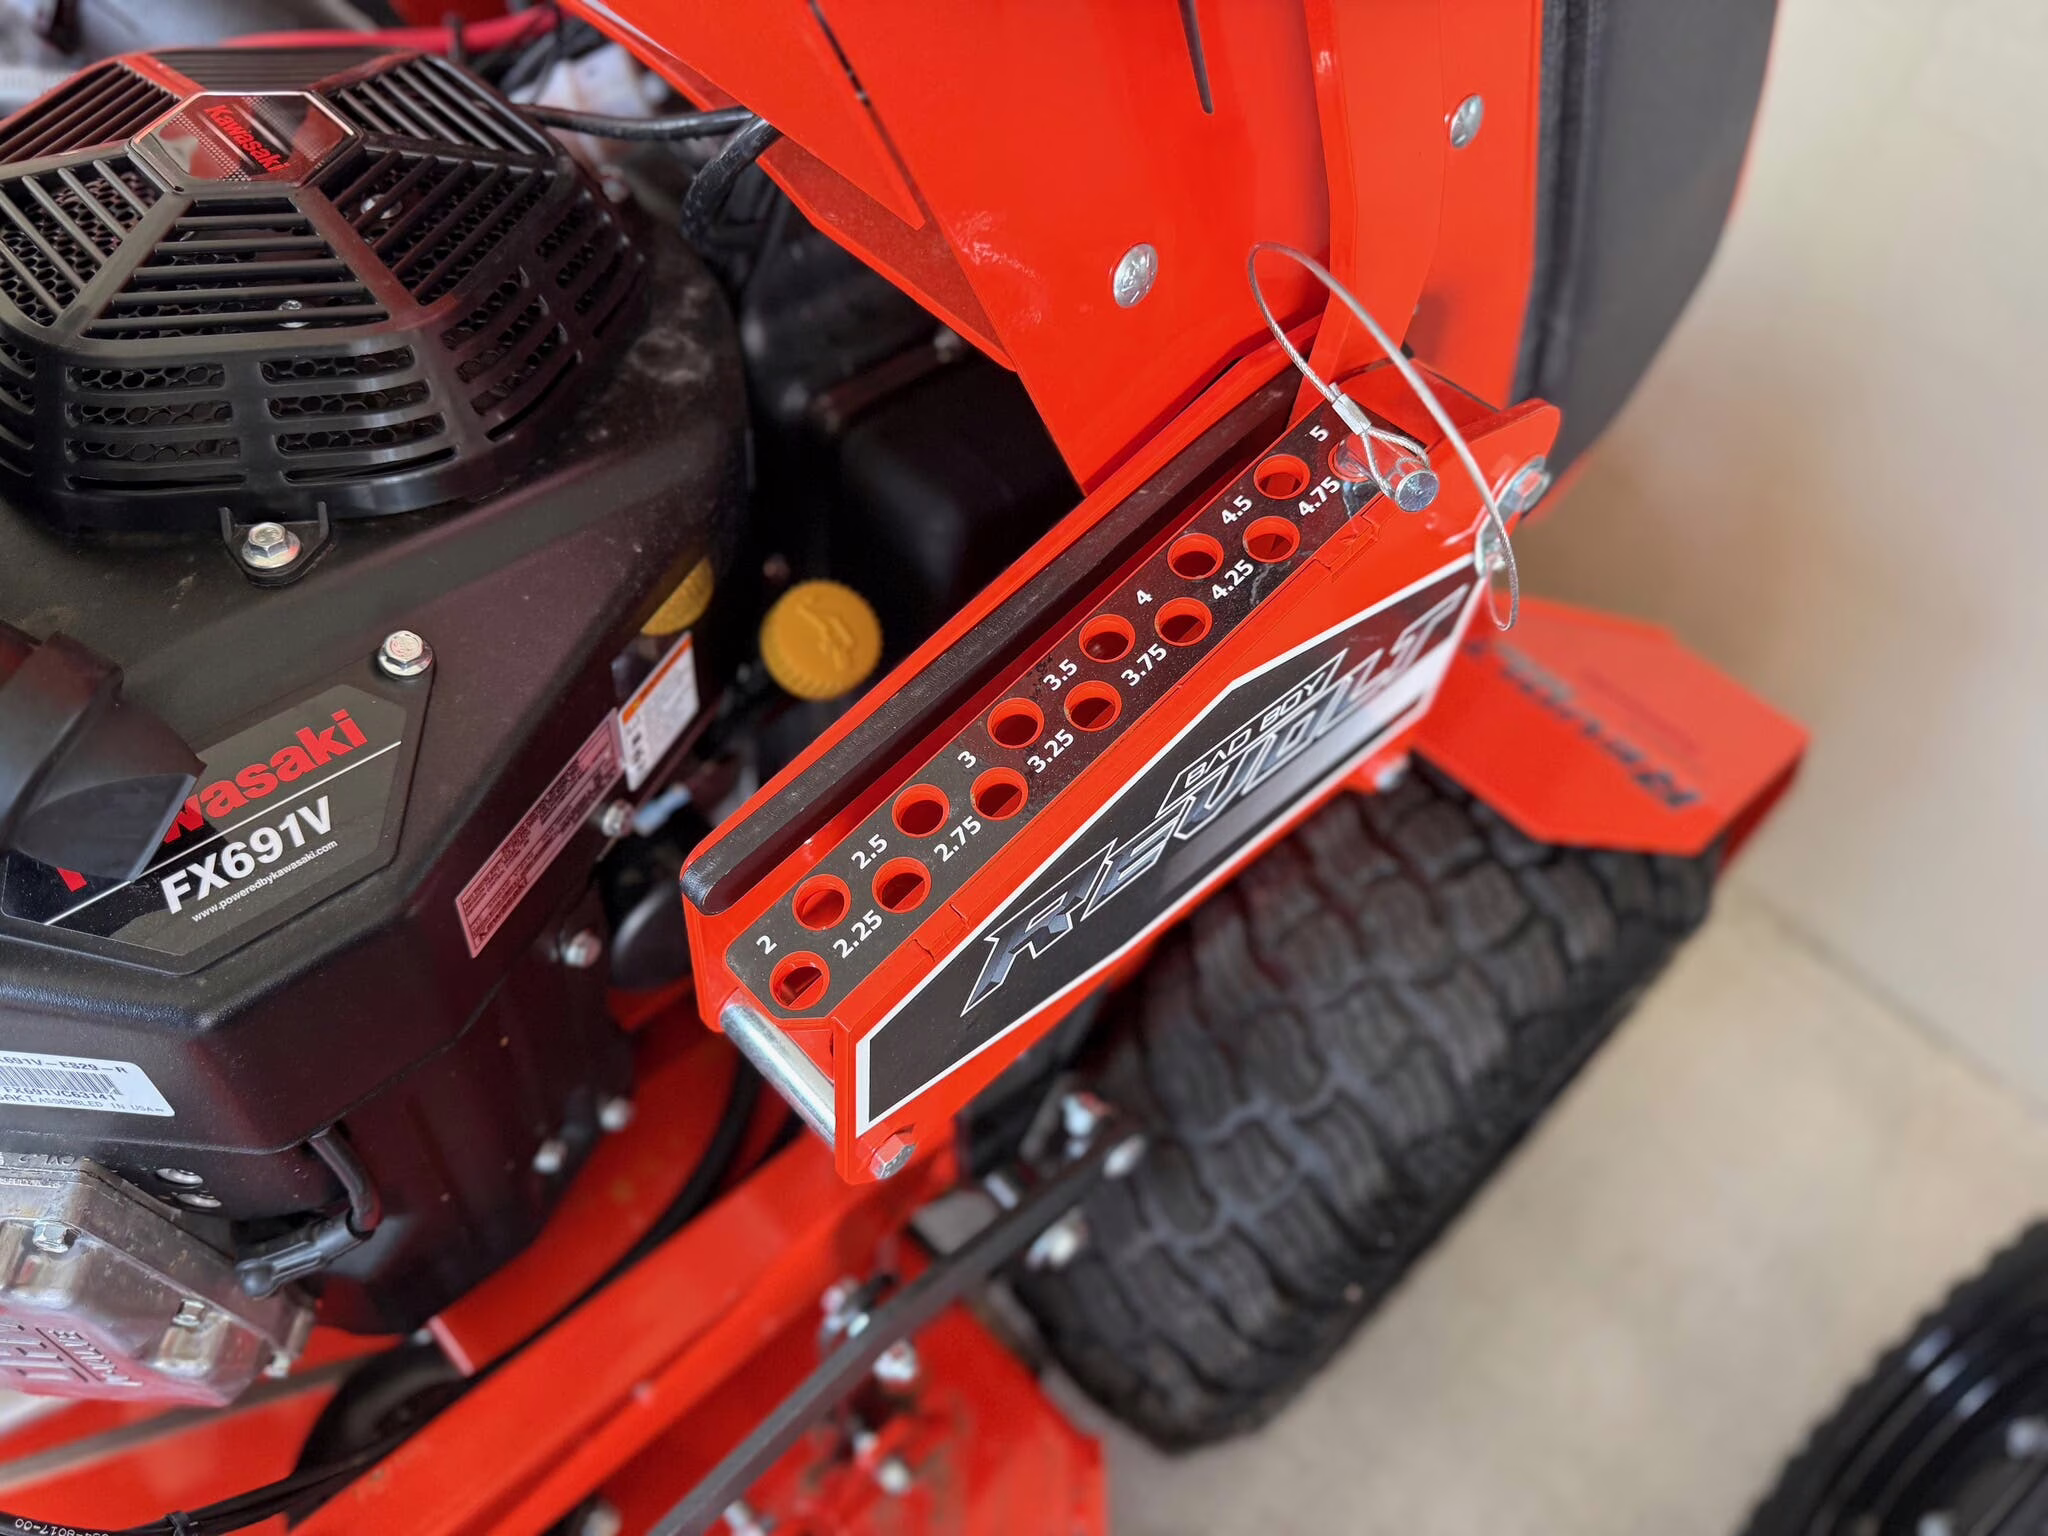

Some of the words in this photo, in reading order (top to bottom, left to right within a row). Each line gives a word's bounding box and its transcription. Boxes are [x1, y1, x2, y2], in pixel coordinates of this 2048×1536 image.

[204, 105, 290, 172] Kawasaki
[1309, 425, 1329, 442] 5
[1221, 495, 1253, 525] 4.5
[1298, 476, 1341, 517] 4.75
[1136, 589, 1153, 606] 4
[1211, 559, 1254, 600] 4.25
[1042, 658, 1078, 691] 3.5
[1120, 643, 1167, 687] 3.75
[1185, 729, 1252, 788] BAD
[1259, 672, 1326, 732] BOY
[957, 750, 977, 769] 3
[1026, 728, 1074, 774] 3.25
[160, 795, 332, 914] FX691V
[850, 833, 888, 870] 2.5
[933, 815, 982, 863] 2.75
[192, 840, 338, 922] www.poweredbykawasaki.com
[755, 934, 778, 955] 2
[832, 908, 883, 959] 2.25
